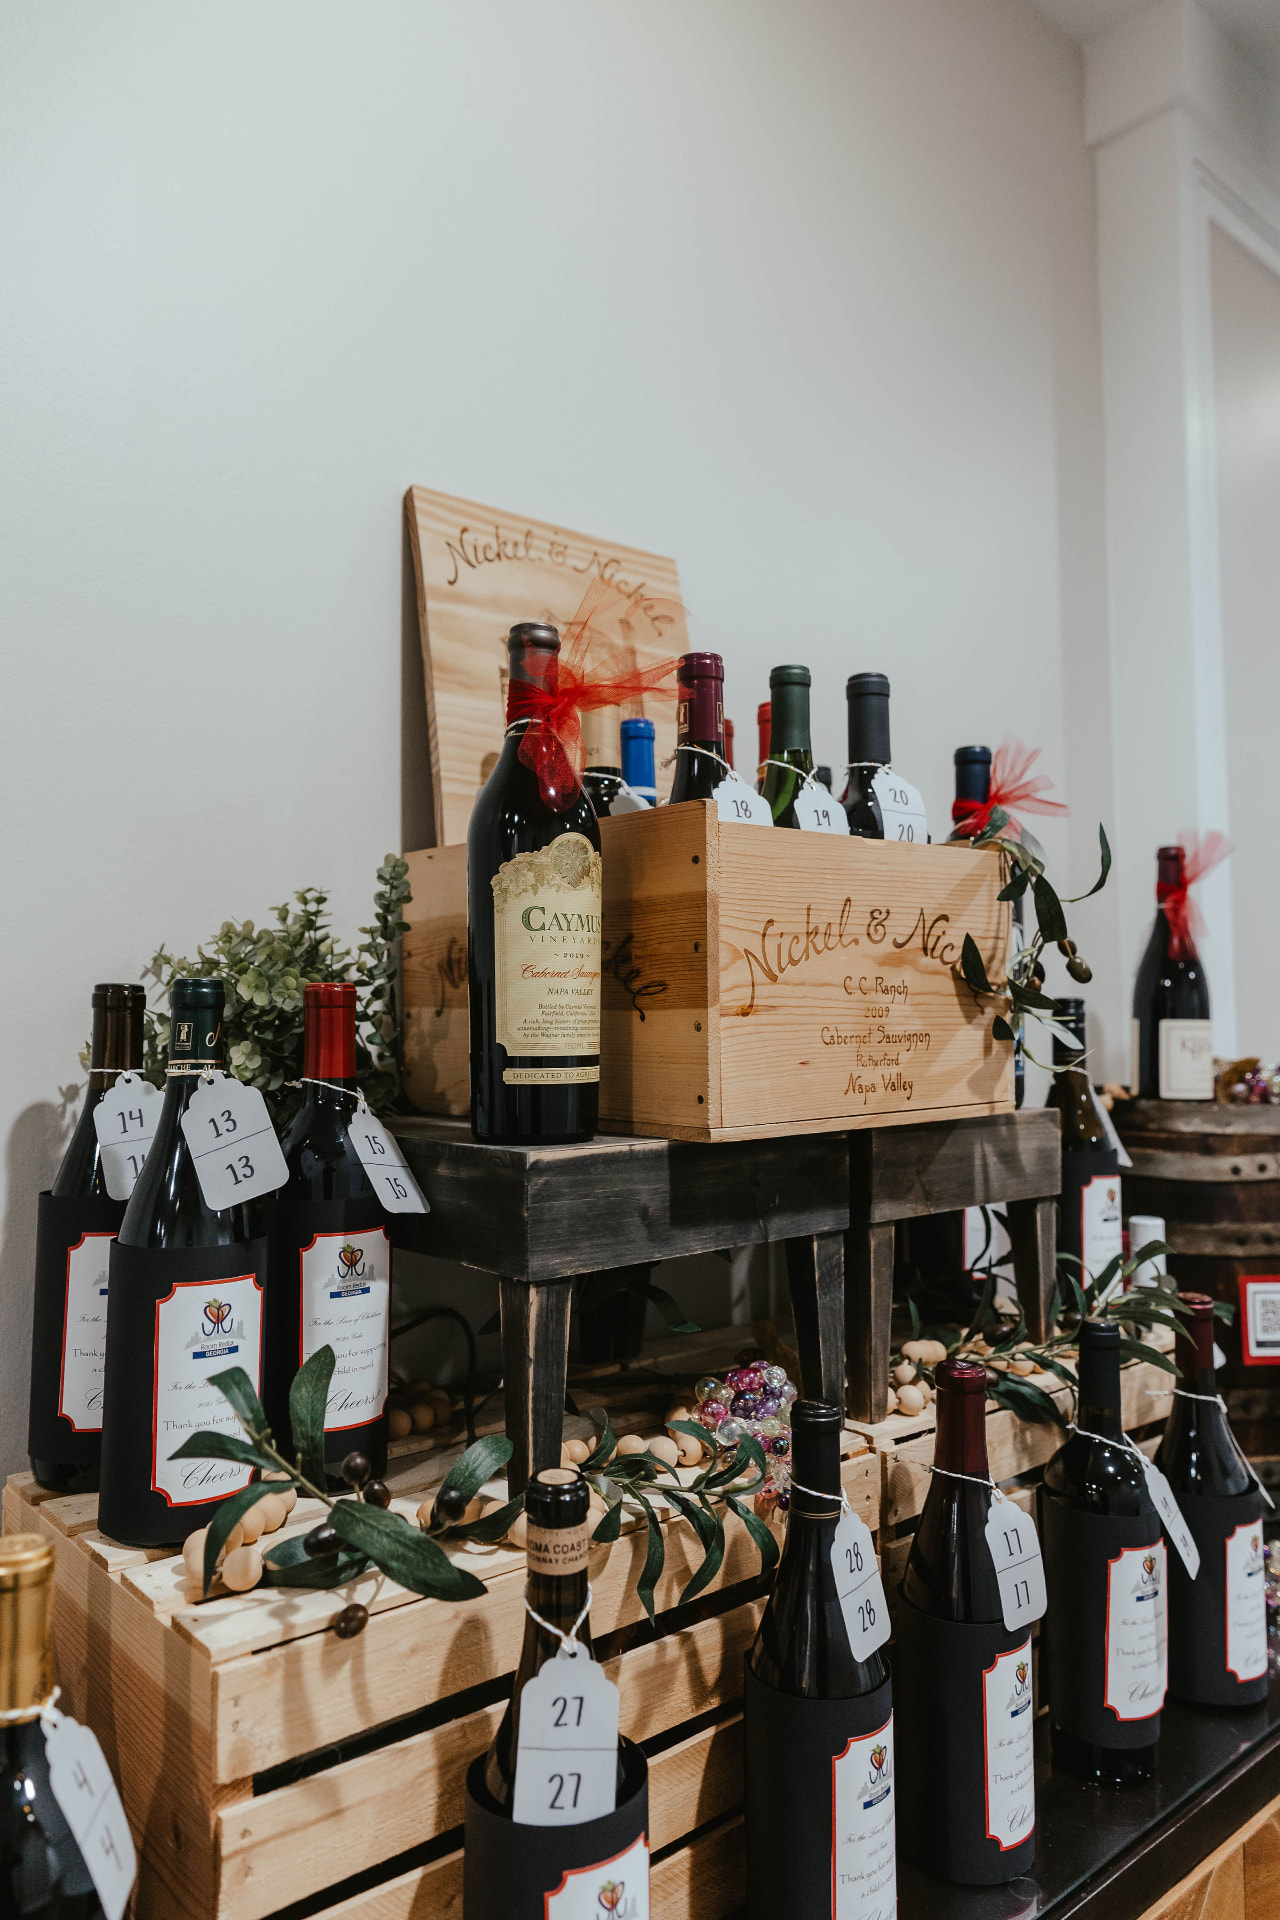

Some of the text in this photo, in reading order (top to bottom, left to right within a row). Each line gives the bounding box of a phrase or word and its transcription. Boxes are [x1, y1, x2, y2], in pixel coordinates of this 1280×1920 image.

[548, 531, 569, 565] &
[732, 800, 752, 819] 18
[888, 787, 909, 806] 20
[813, 809, 831, 827] 19
[898, 823, 914, 843] 20
[740, 896, 962, 1017] Nickel & Nic
[521, 963, 571, 980] Cabernet
[547, 987, 594, 996] NAPA VALLEY
[875, 976, 908, 1004] Ranch
[864, 1006, 890, 1019] 2009
[820, 1025, 931, 1053] Cabernet Sauvignon
[856, 1052, 901, 1070] Rutherford
[512, 1072, 562, 1080] DEDICATED
[844, 1072, 913, 1105] Napa Valley
[116, 1108, 144, 1135] 14
[208, 1109, 238, 1139] 13
[364, 1133, 386, 1155] 15
[224, 1155, 255, 1186] 13
[385, 1176, 408, 1200] 15
[72, 1348, 98, 1358] Thank
[205, 1348, 230, 1357] GEORGIA
[163, 1419, 193, 1431] Thank
[194, 1420, 211, 1431] you
[212, 1414, 225, 1425] for
[1002, 1528, 1024, 1556] 17
[845, 1541, 864, 1574] 28
[1013, 1580, 1032, 1609] 17
[857, 1598, 876, 1633] 28
[551, 1695, 586, 1727] 27
[72, 1759, 95, 1798] 4
[548, 1771, 583, 1810] 27
[100, 1824, 123, 1873] 4
[839, 1870, 866, 1885] Thank
